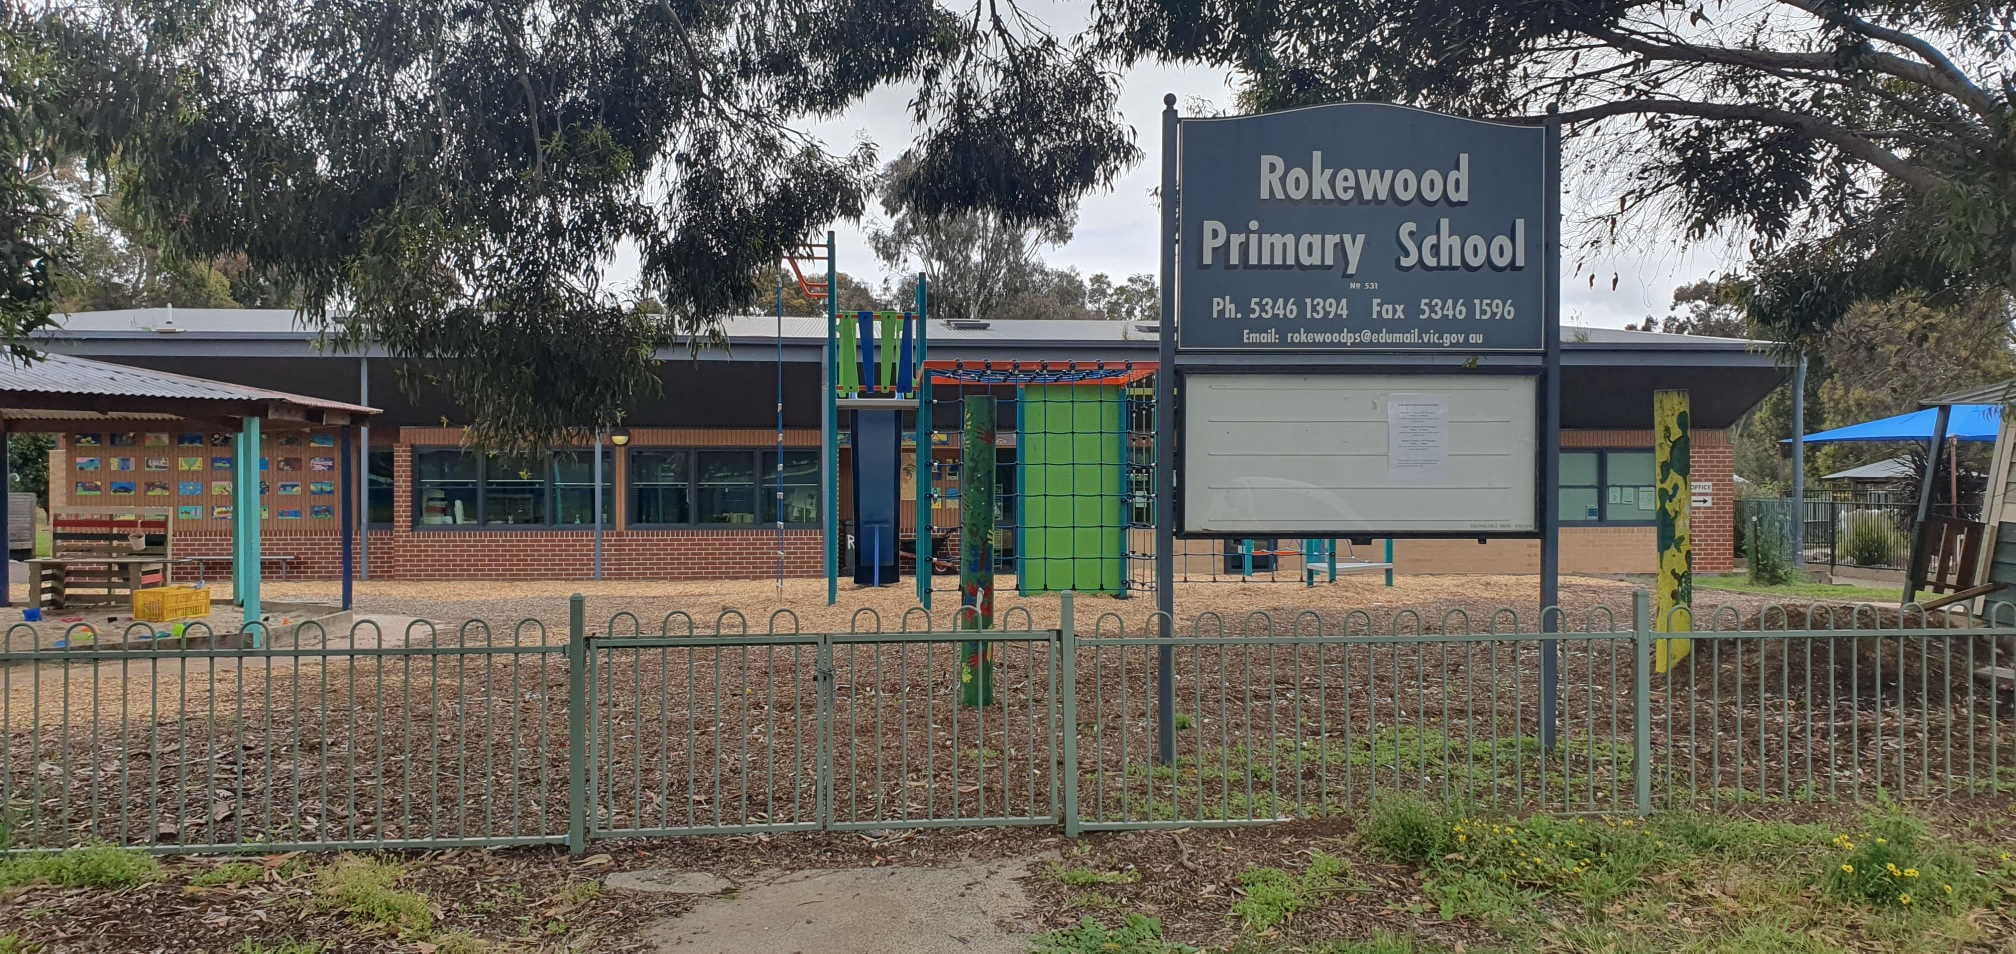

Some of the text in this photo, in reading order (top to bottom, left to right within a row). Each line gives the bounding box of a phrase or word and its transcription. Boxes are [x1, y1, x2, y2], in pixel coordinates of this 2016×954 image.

[1260, 150, 1469, 203] Rokewood
[1202, 217, 1526, 275] Primary School
[1365, 282, 1378, 290] 531
[1212, 295, 1515, 320] Ph. 5346 1394 Fax 5346 1596
[1243, 328, 1280, 343] Email:
[1287, 328, 1465, 346] rokewoodps@edumail.vic.gov
